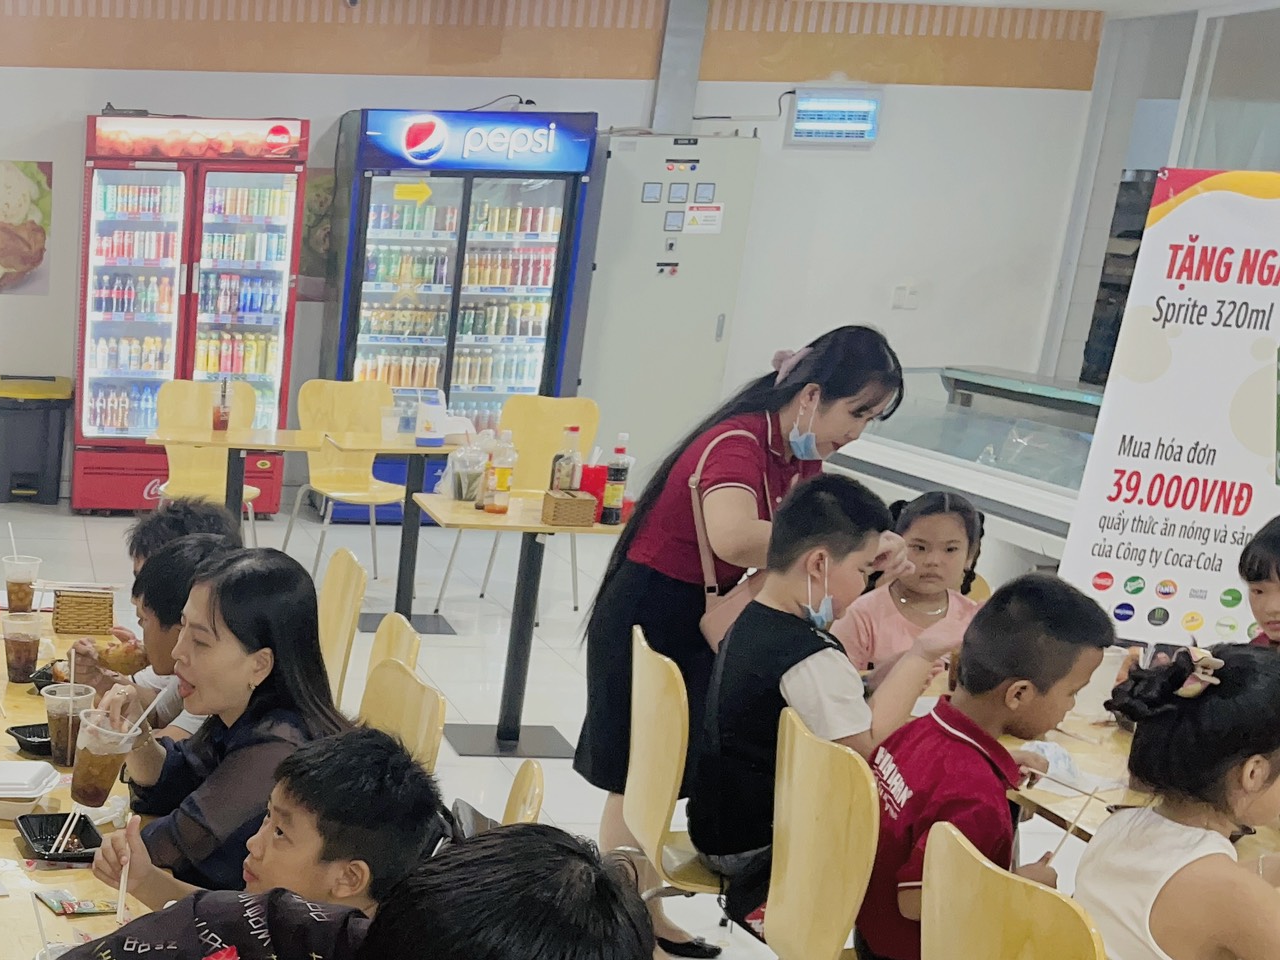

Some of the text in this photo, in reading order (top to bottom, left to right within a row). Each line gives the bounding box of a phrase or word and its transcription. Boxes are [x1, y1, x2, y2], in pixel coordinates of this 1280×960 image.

[462, 122, 556, 159] pepsi
[1166, 234, 1235, 290] TẶNG
[1152, 295, 1275, 331] Sprite 320ml
[1118, 434, 1217, 466] Mua hóa đơn
[1107, 469, 1253, 516] 39.000VNĐ
[1099, 510, 1129, 535] quầy
[1131, 514, 1158, 535] thức
[1160, 518, 1176, 537] ăn
[1179, 521, 1210, 545] nóng
[1214, 525, 1227, 543] và
[1091, 538, 1112, 558] của
[1116, 543, 1149, 567] Công
[1149, 547, 1162, 568] ty
